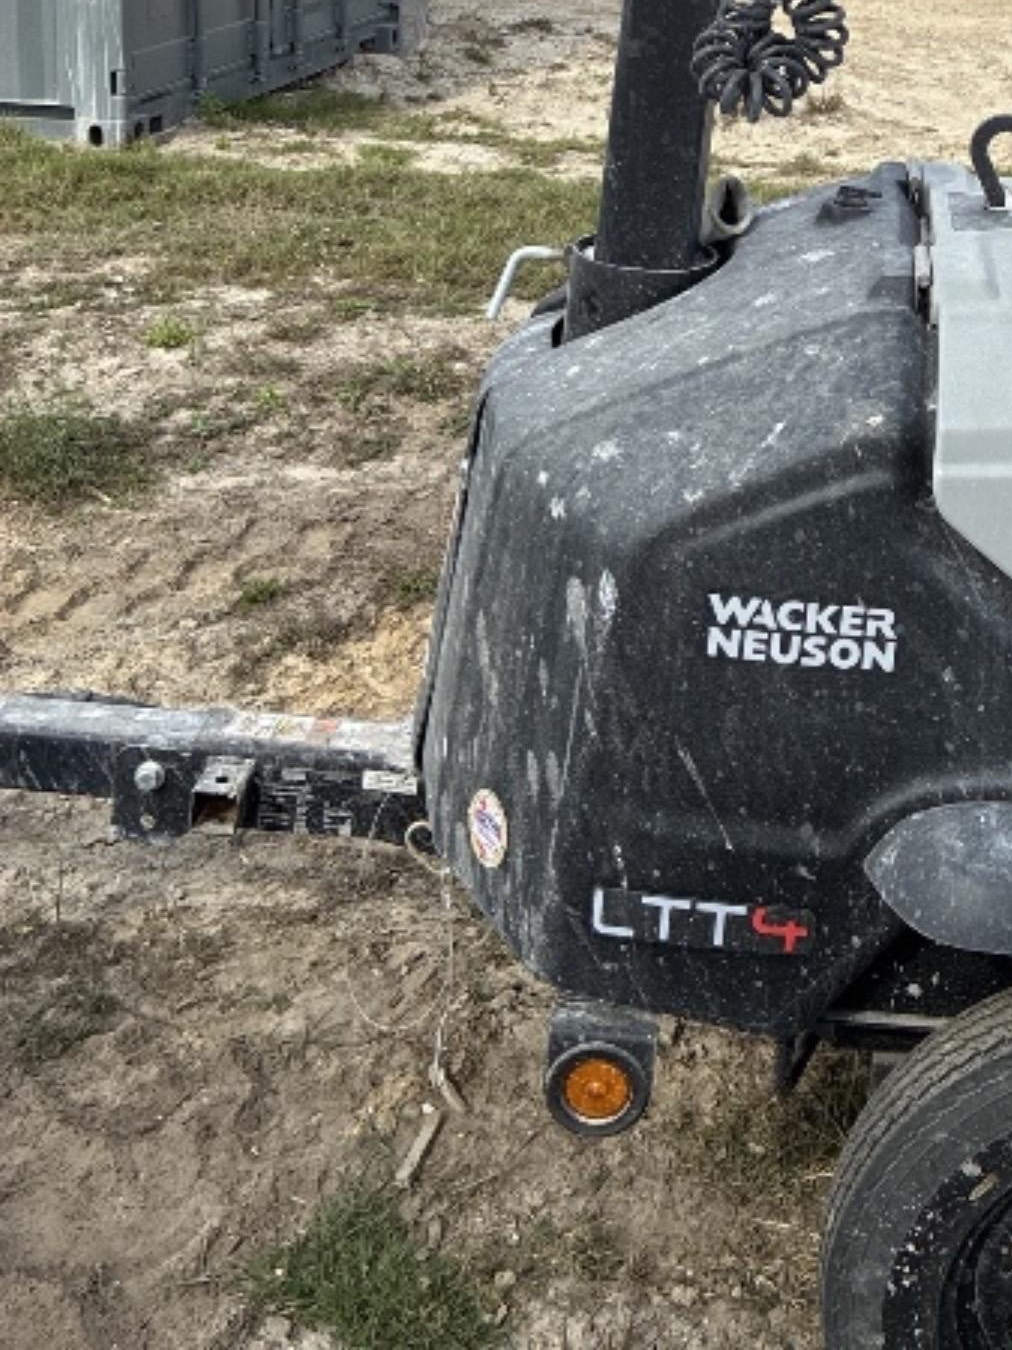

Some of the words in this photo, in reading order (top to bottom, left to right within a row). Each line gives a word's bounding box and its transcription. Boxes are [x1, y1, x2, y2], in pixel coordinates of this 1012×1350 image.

[708, 593, 898, 640] WACKER
[706, 627, 897, 673] NEUSON
[592, 887, 808, 954] LTT4
